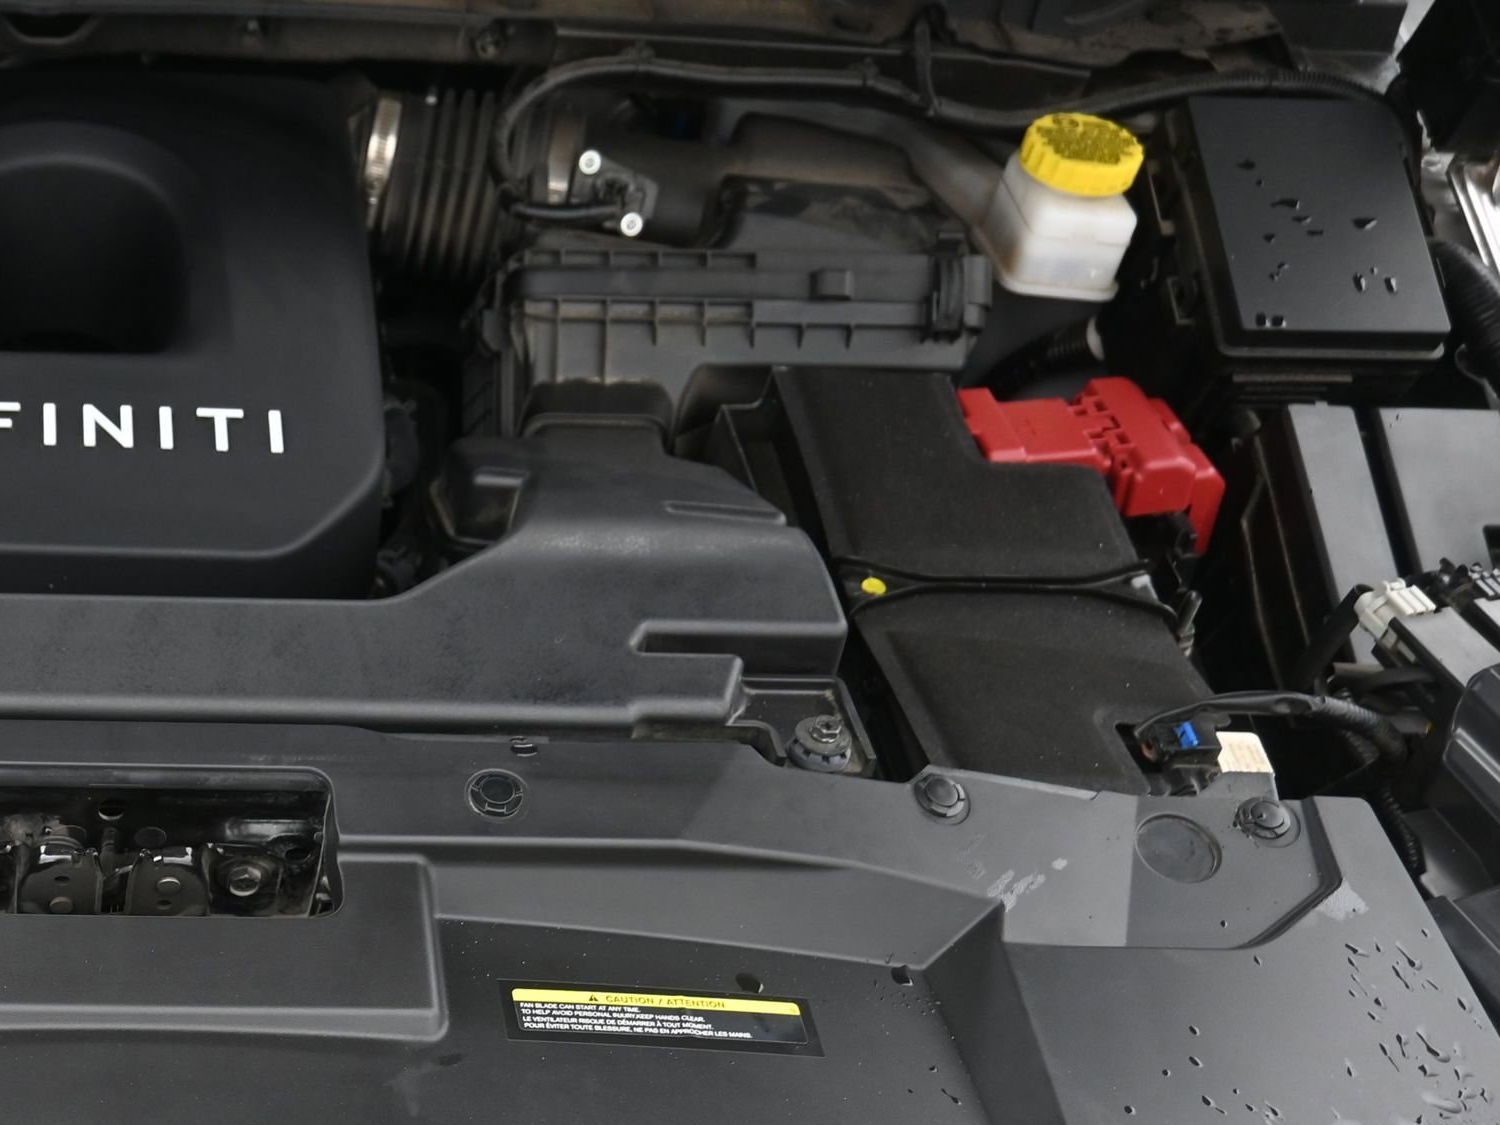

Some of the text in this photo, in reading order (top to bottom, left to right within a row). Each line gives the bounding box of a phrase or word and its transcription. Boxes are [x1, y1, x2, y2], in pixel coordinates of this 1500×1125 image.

[605, 995, 654, 1005] CAUTION
[666, 998, 725, 1009] ATTENTION
[574, 1010, 612, 1018] PERSONAL
[681, 1015, 705, 1023] CLEAR.
[662, 1021, 681, 1029] TOUT
[670, 1028, 713, 1036] APPROCHER
